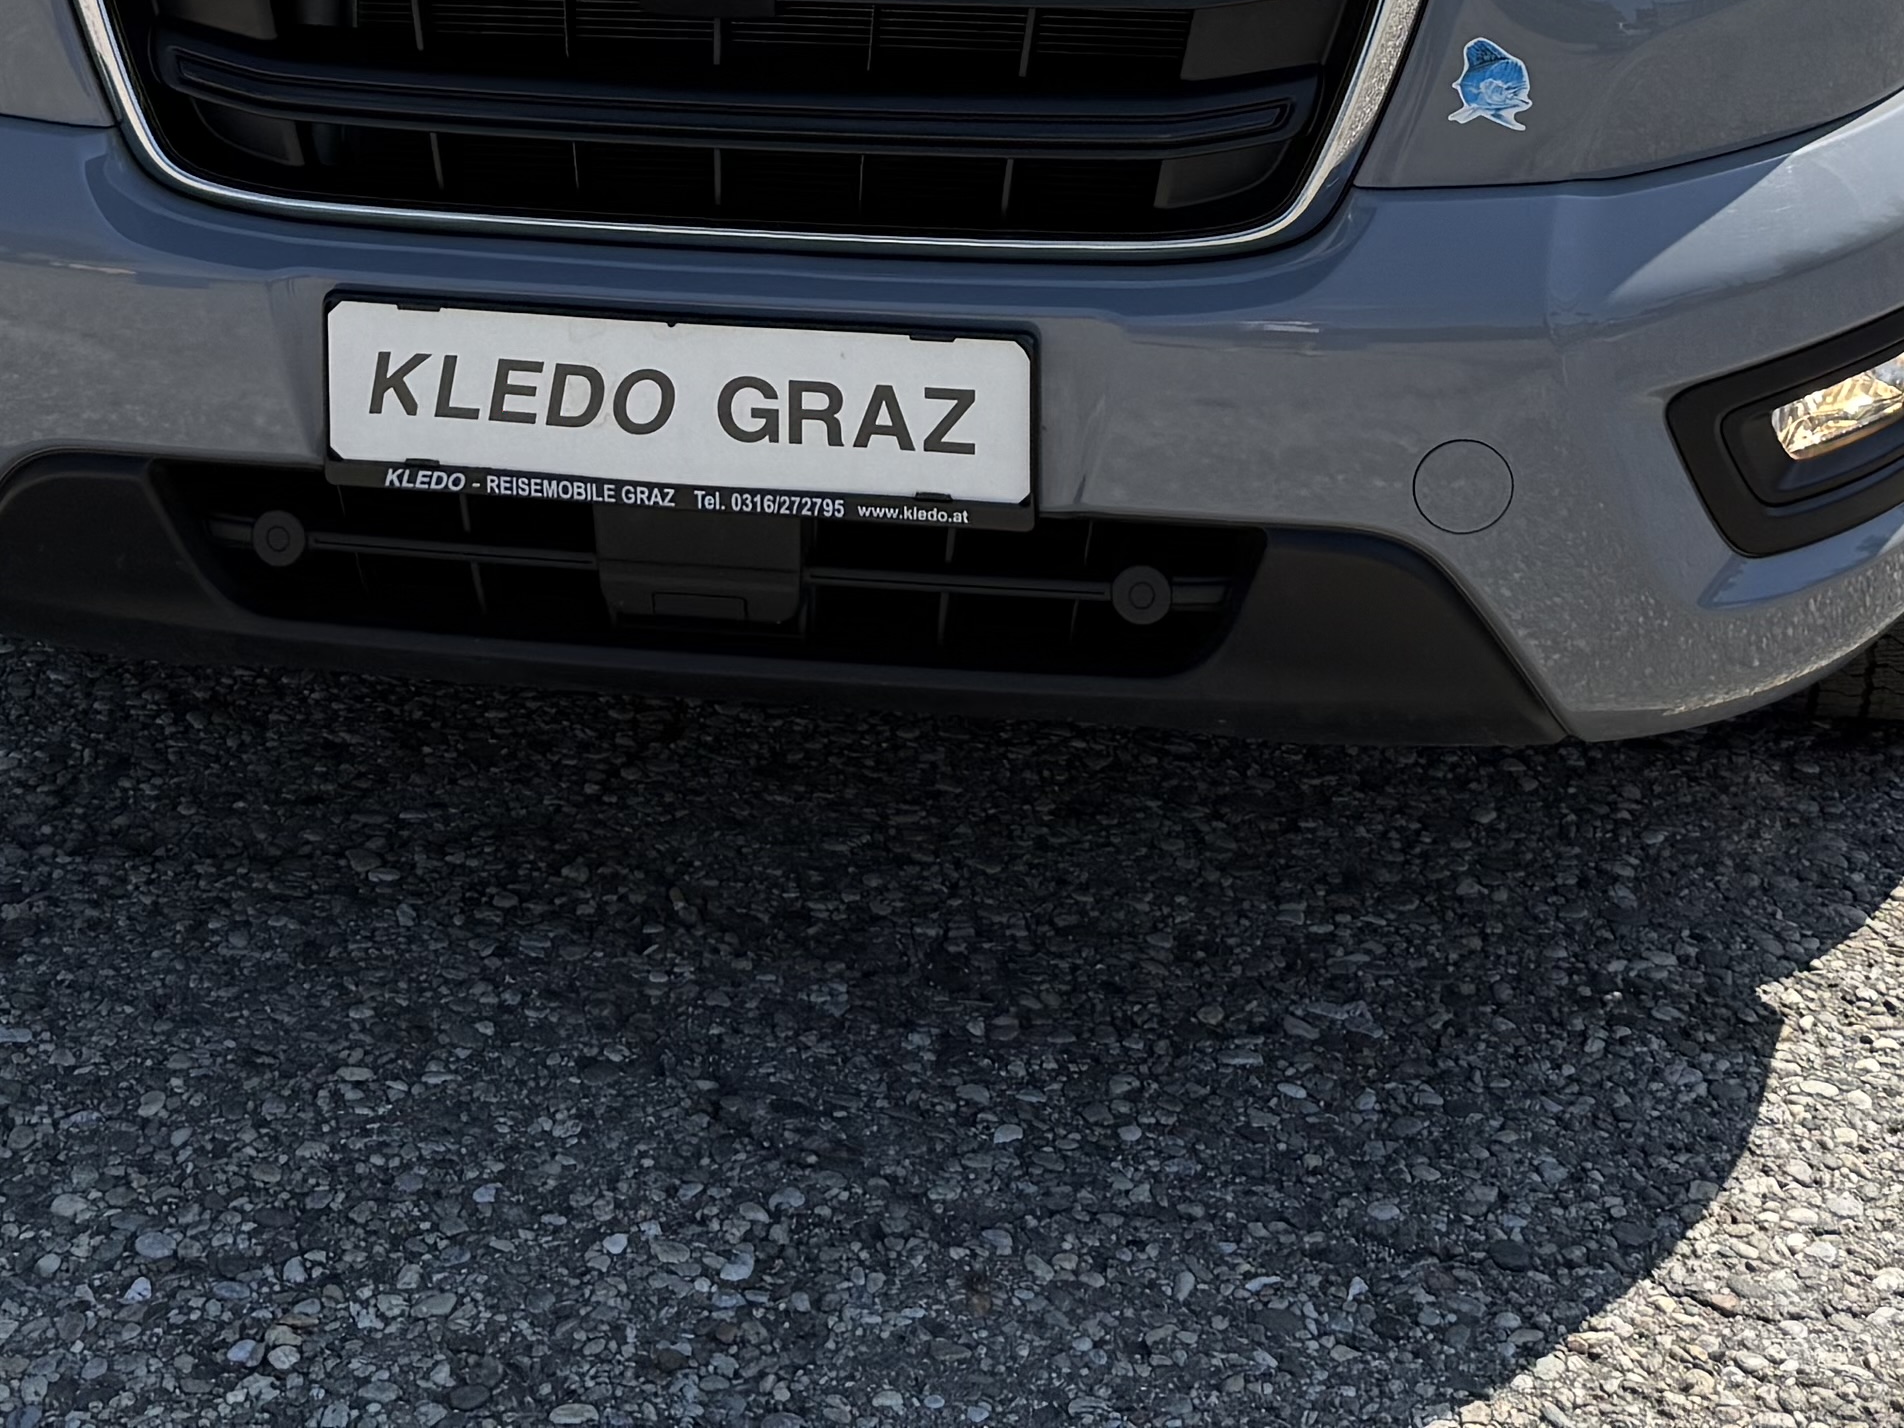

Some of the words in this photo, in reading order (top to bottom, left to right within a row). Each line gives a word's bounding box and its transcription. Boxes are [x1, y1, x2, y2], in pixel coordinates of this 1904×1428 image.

[367, 349, 678, 436] KLEDO
[715, 374, 978, 456] GRAZ
[384, 467, 467, 492] KLEDO
[485, 474, 617, 503] REISEMOBILE
[621, 485, 676, 507] GRAZ
[693, 490, 726, 511] Tel.
[730, 493, 845, 518] 0316/272795
[856, 503, 969, 524] www.kledo.at
